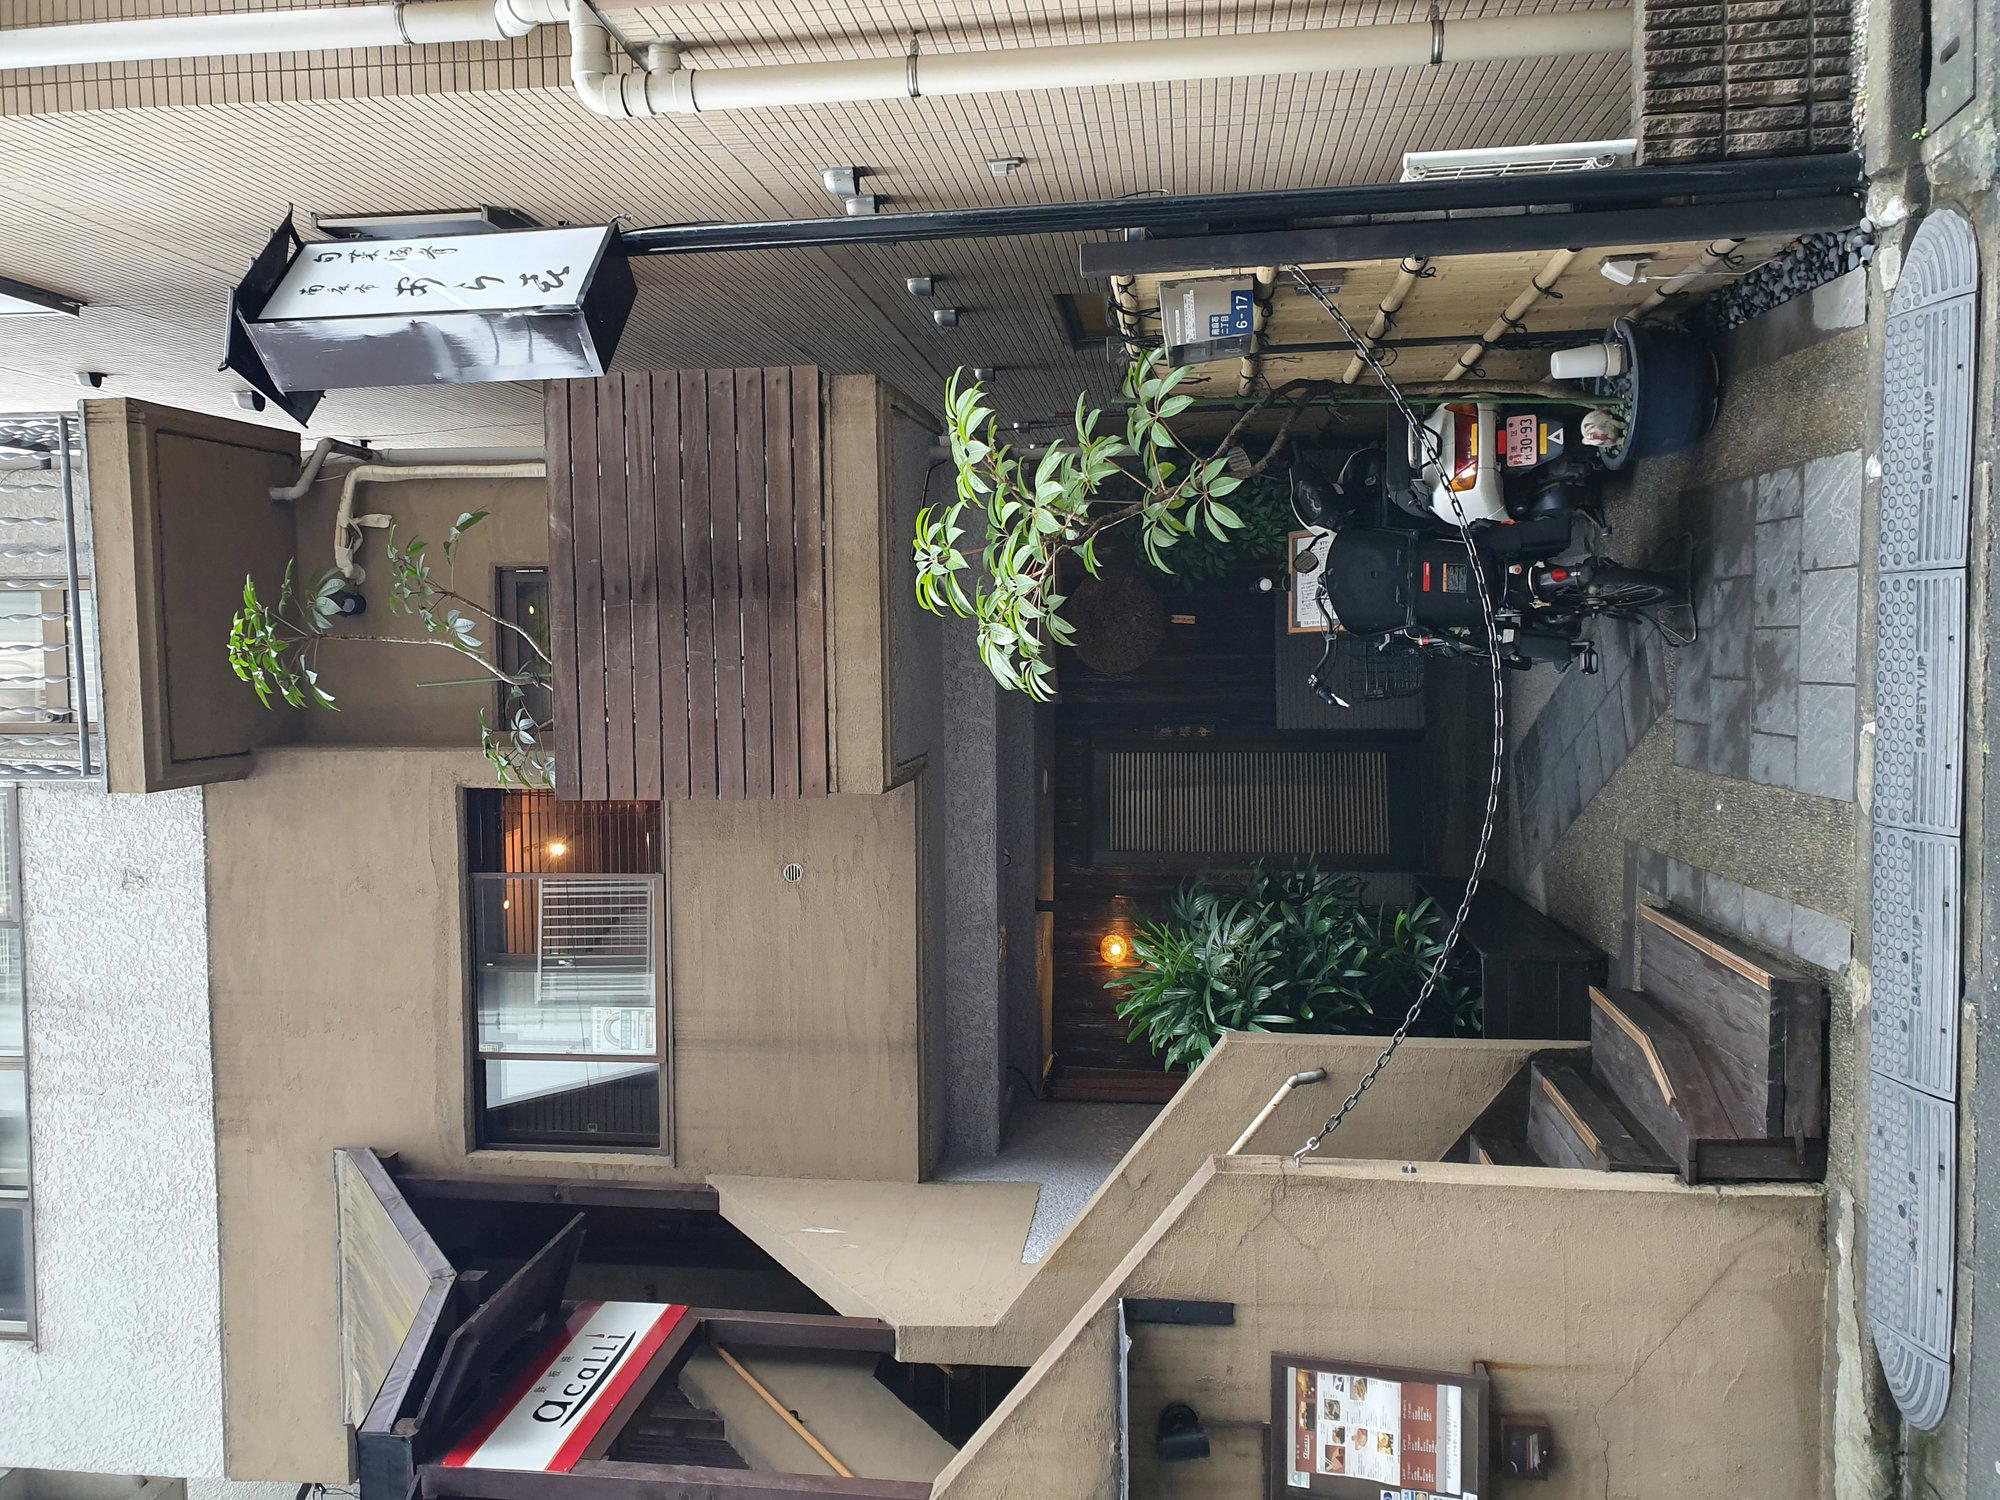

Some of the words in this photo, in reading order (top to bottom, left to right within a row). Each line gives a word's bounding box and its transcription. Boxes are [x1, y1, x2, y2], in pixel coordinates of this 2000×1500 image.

[1220, 315, 1229, 334] 二丁目
[1235, 295, 1248, 329] 6-17
[532, 1333, 626, 1423] acalli
